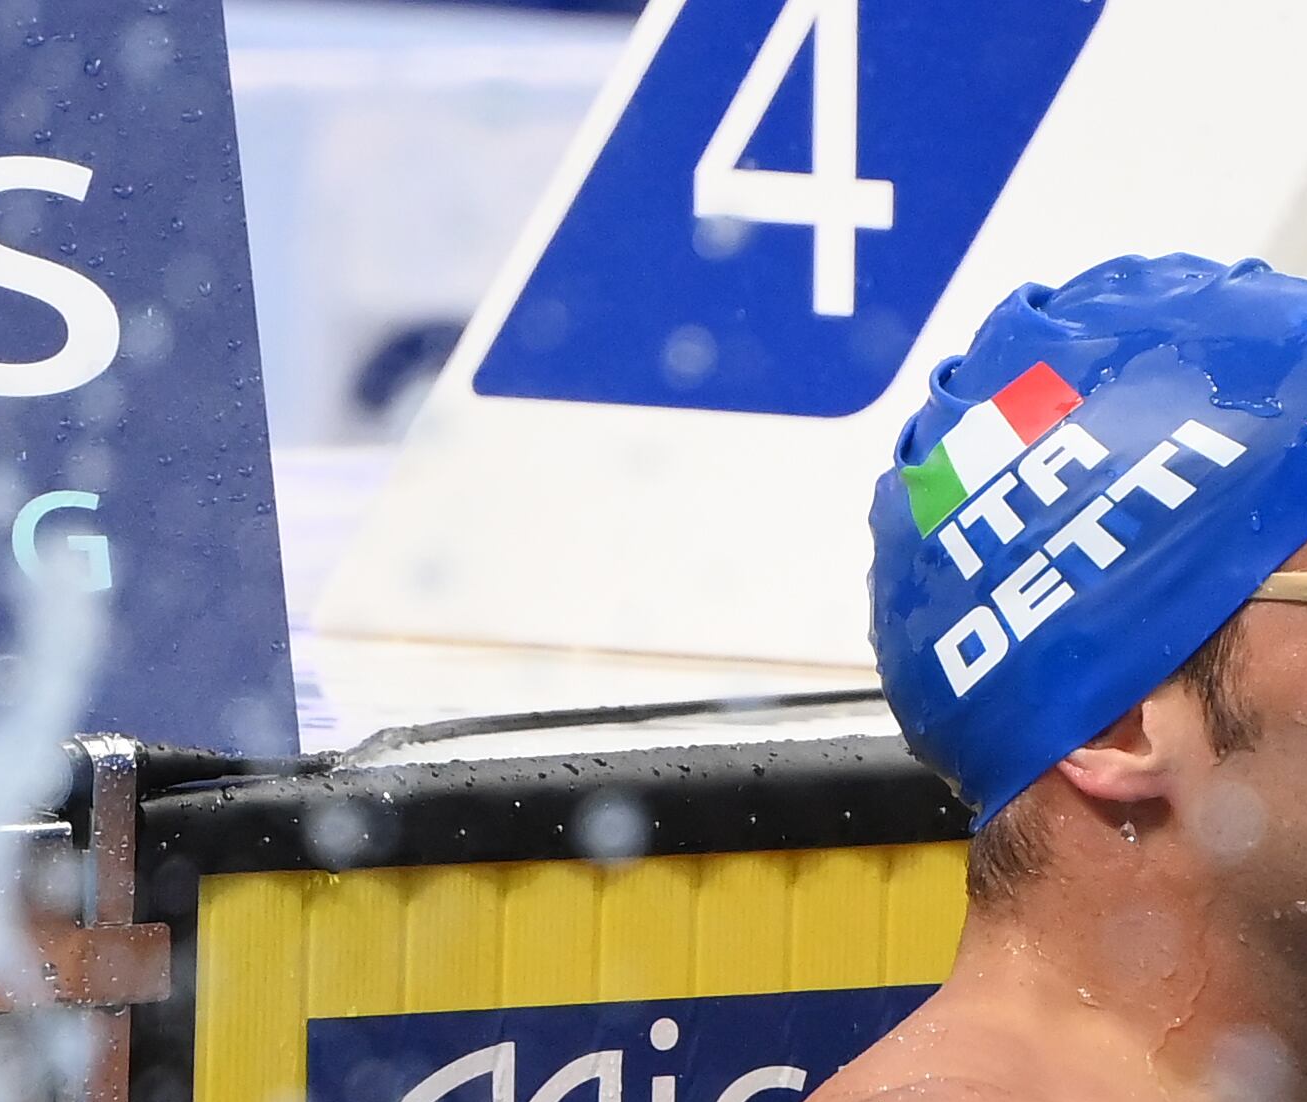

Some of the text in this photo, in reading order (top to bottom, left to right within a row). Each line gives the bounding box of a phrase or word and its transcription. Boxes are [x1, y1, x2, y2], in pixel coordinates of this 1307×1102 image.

[693, 0, 893, 317] 4
[932, 418, 1248, 698] DETTI
[937, 422, 1111, 581] ITA
